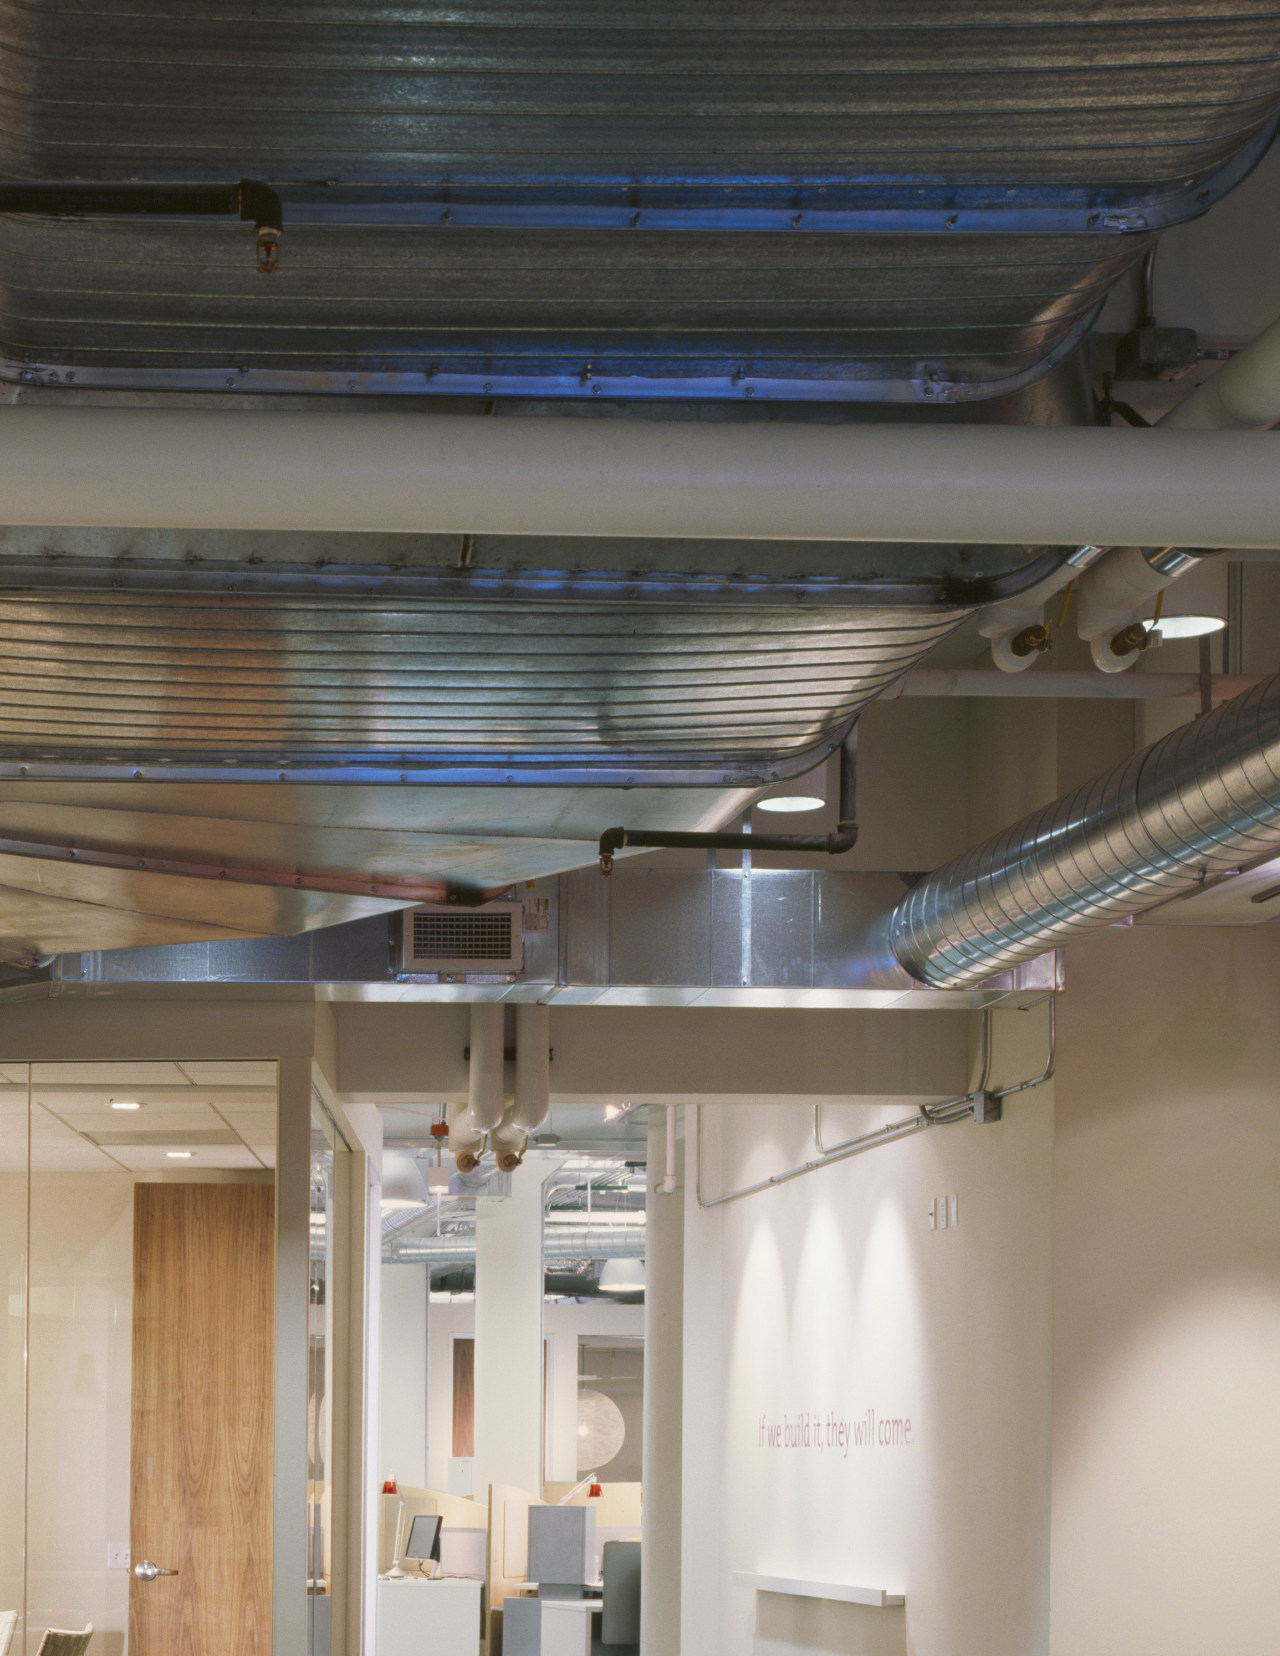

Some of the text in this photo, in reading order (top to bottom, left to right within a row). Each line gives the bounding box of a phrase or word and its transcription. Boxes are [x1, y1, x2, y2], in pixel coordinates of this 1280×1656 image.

[767, 1424, 782, 1448] we
[783, 1412, 811, 1448] build
[825, 1410, 851, 1459] they
[853, 1408, 875, 1446] will
